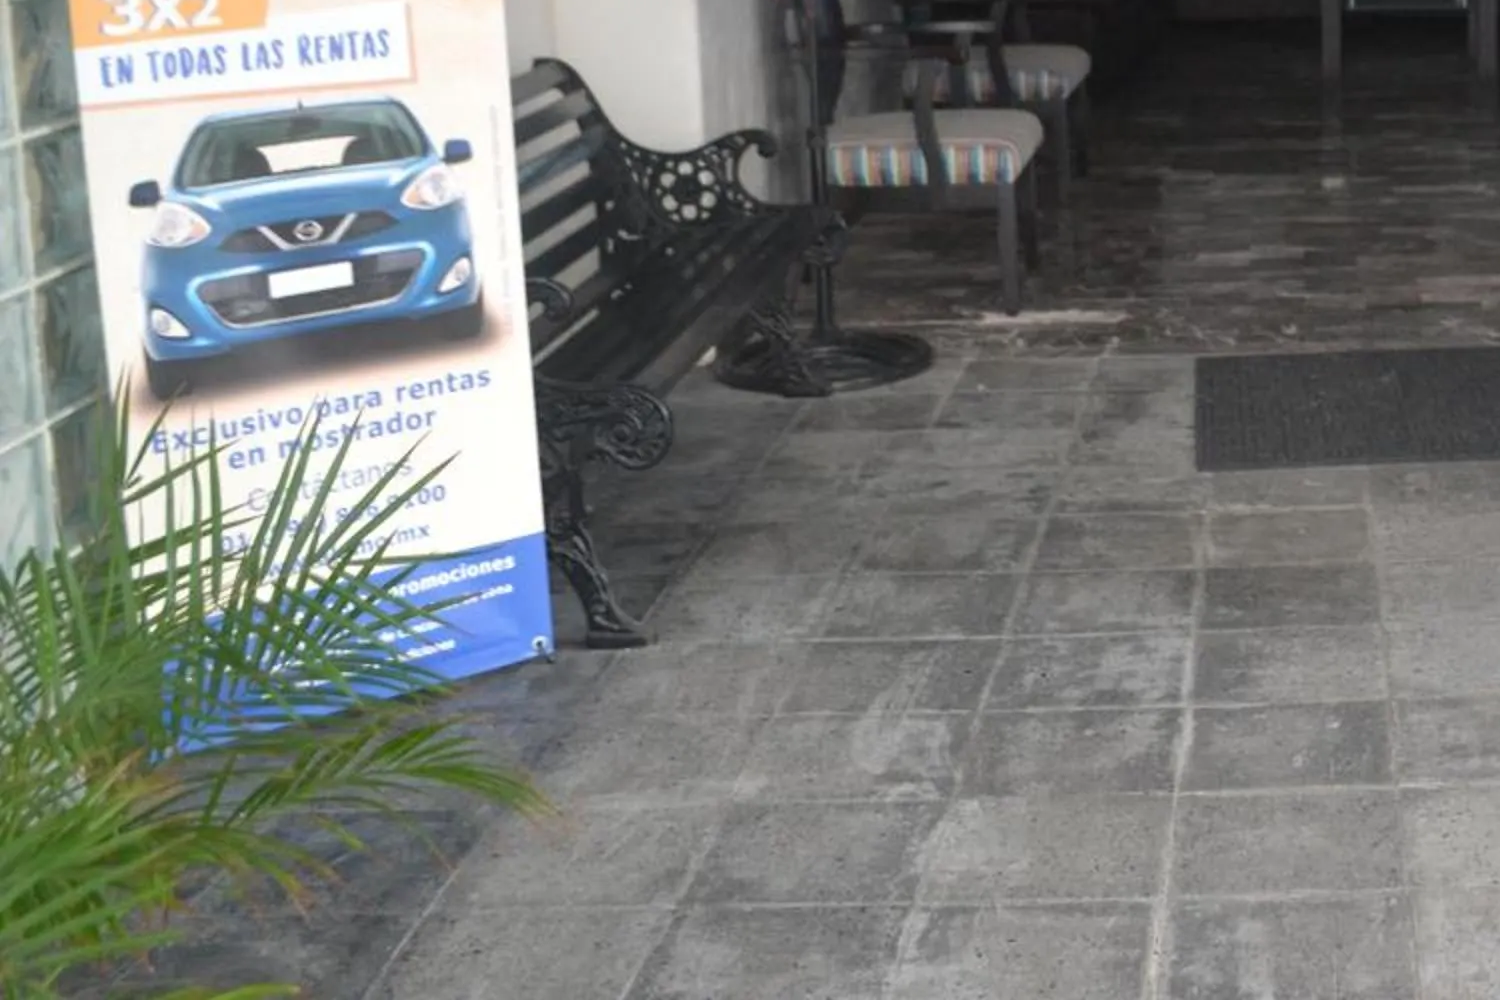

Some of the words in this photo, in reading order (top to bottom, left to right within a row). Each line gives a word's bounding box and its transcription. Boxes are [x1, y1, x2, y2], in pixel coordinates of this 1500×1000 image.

[100, 55, 134, 88] EN
[146, 44, 228, 83] TODAS
[241, 38, 285, 72] LAS
[297, 28, 391, 67] RENTAS
[316, 389, 382, 424] para
[396, 369, 491, 402] rentas
[227, 446, 265, 469] en
